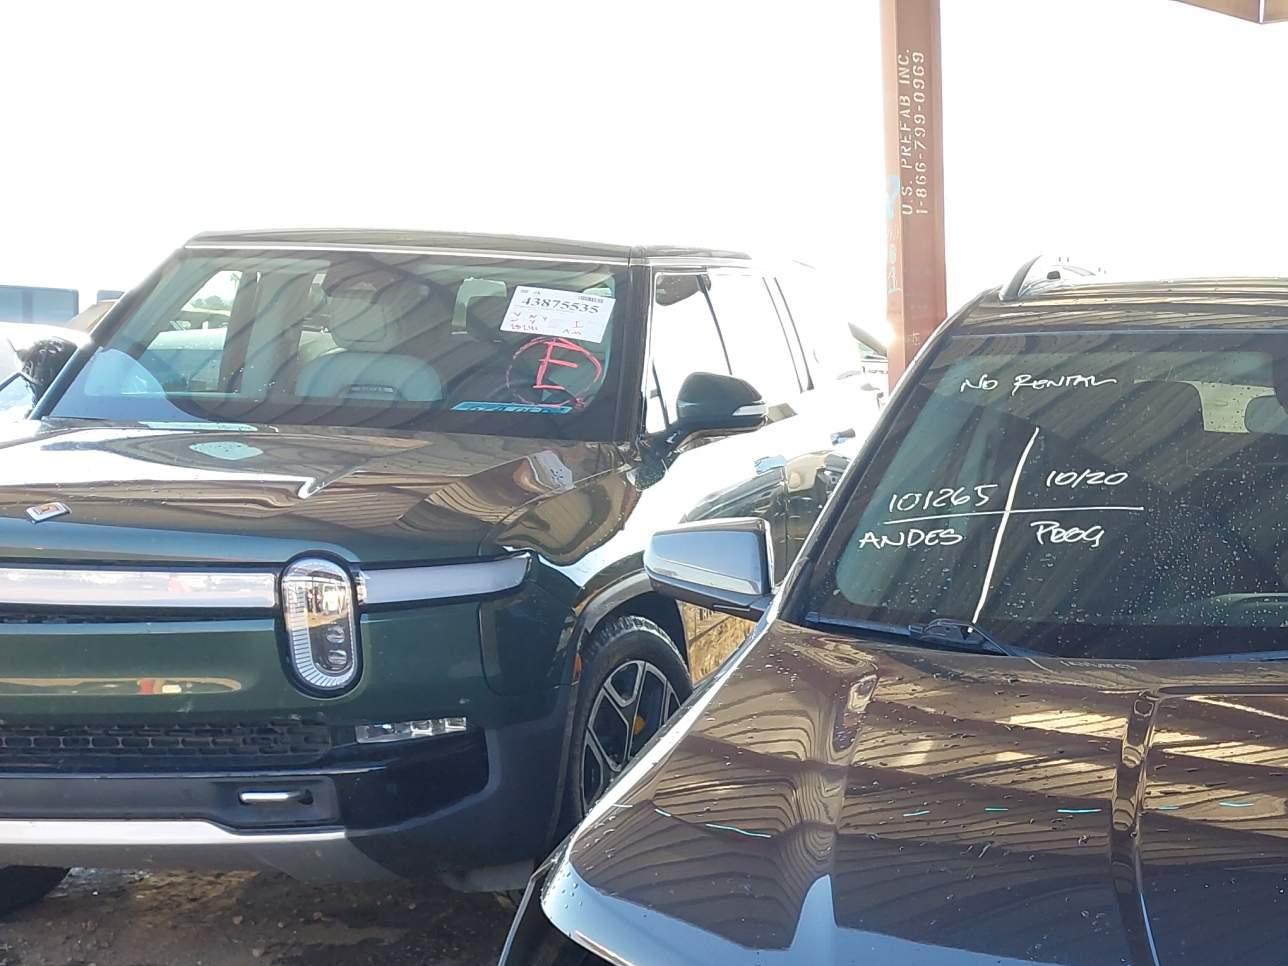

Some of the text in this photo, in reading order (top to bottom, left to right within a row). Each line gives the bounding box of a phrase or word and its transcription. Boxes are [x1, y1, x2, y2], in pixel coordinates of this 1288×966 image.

[897, 49, 913, 215] U.S. PREFAB INC.
[912, 51, 928, 214] 1-866-799-0969
[521, 296, 600, 314] 43875535
[960, 374, 998, 393] NO
[1046, 469, 1129, 489] 10/20
[889, 484, 999, 512] 101265
[858, 528, 963, 550] ANDES
